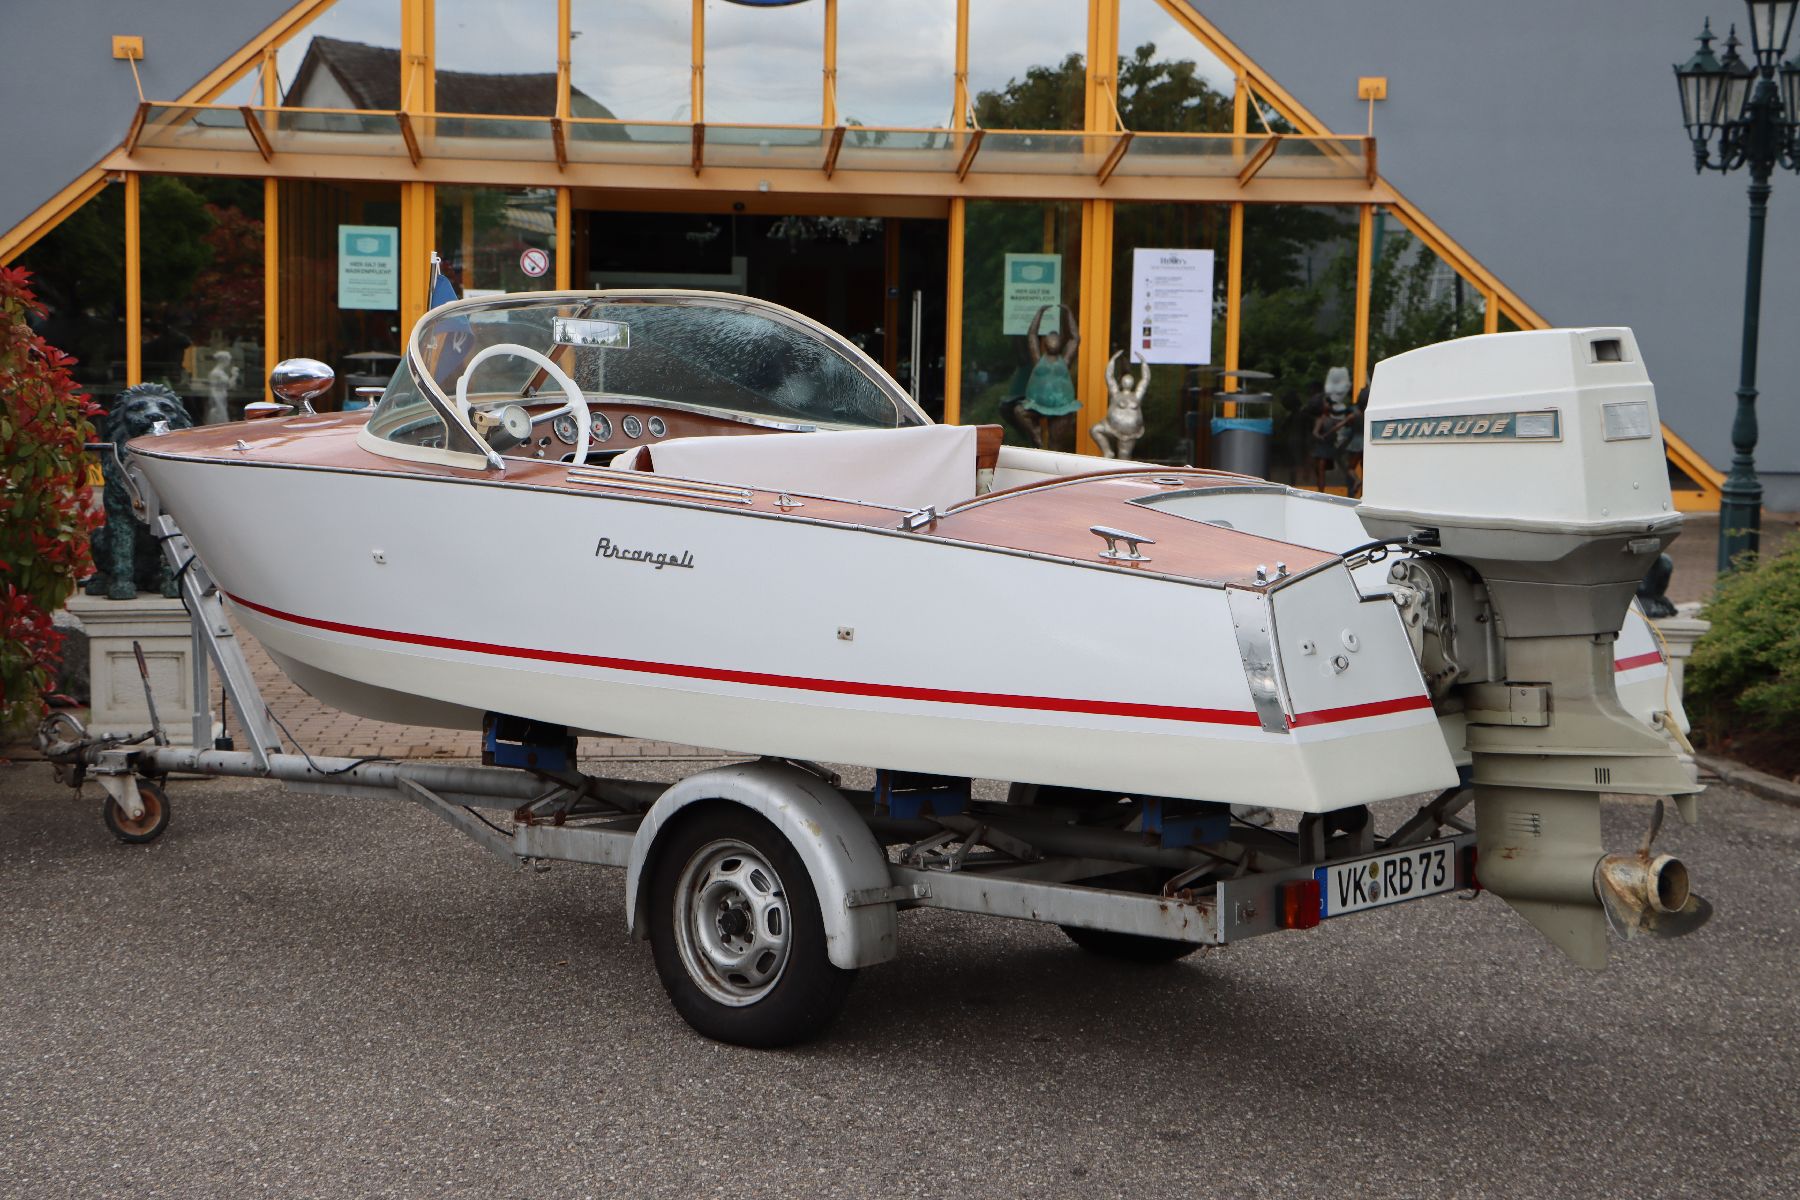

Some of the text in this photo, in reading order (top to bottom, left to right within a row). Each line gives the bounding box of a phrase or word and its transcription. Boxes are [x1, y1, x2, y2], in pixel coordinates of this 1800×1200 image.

[1381, 418, 1511, 438] EVINRUDE
[1338, 849, 1446, 907] VK RB 73
